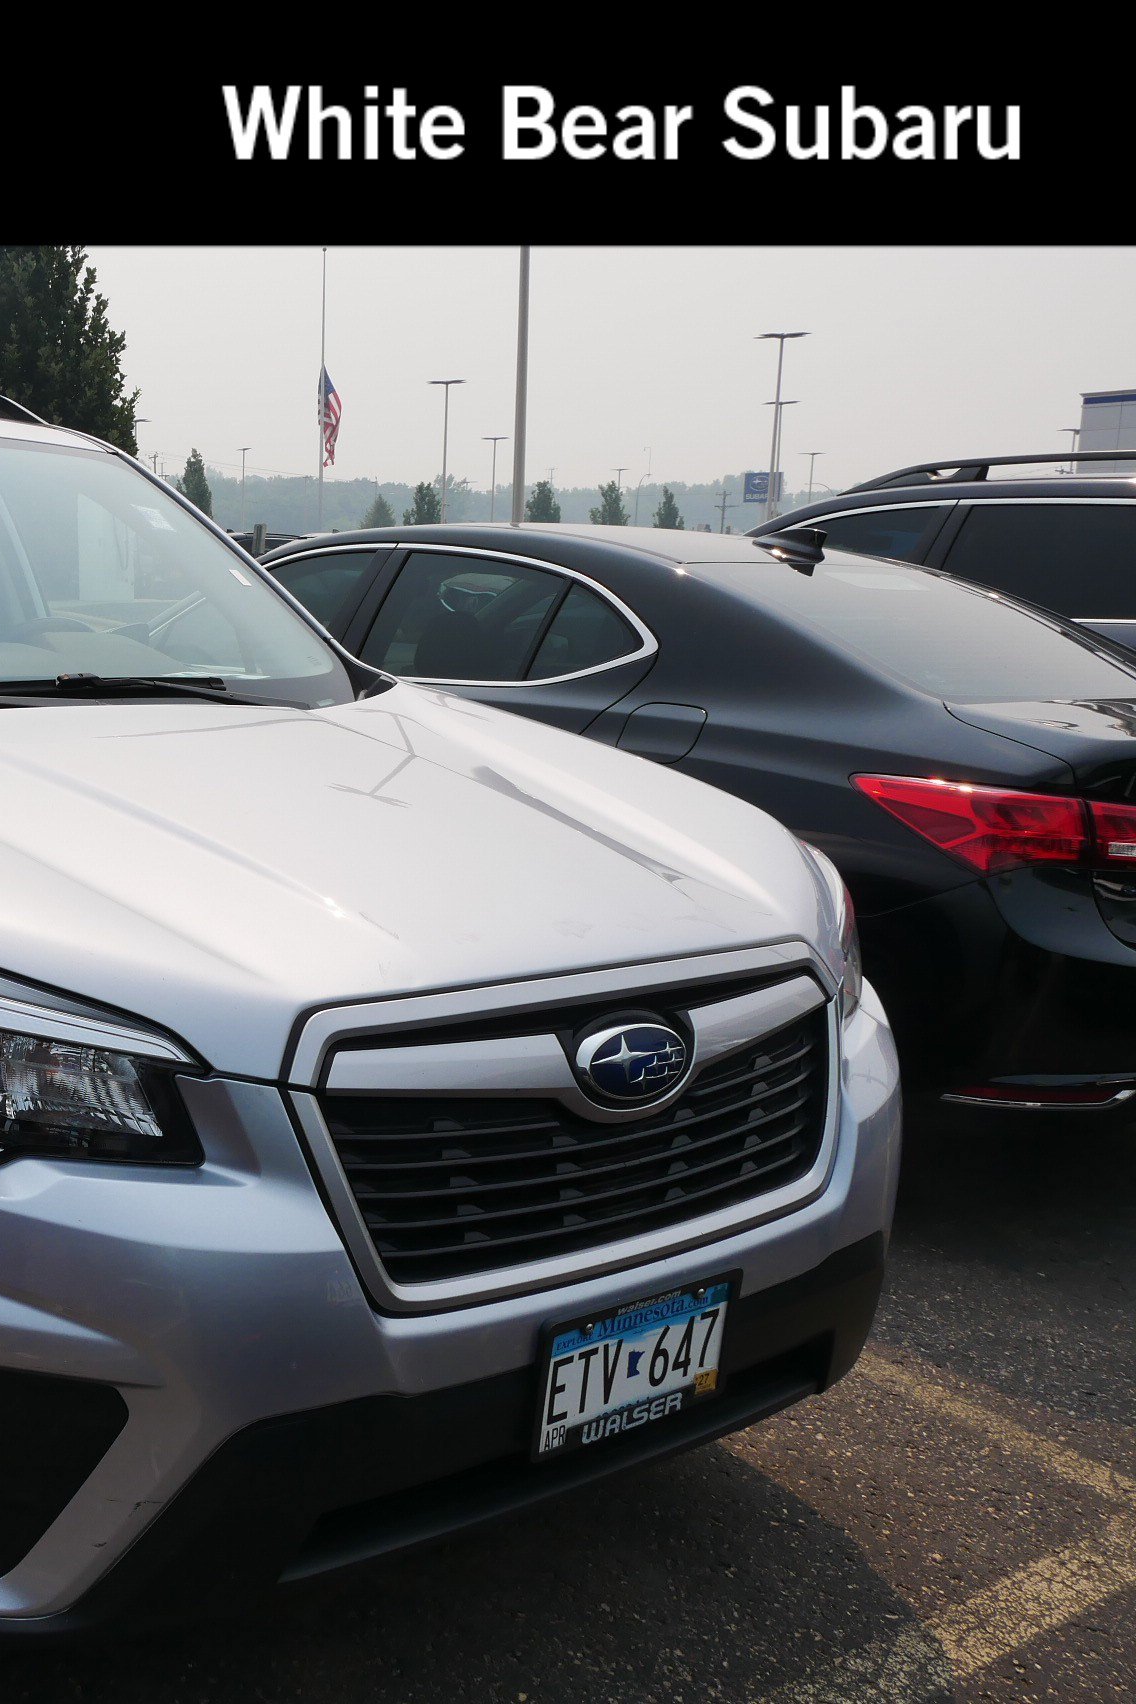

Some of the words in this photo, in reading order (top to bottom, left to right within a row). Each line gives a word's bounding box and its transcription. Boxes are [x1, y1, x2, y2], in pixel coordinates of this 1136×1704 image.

[546, 1338, 624, 1426] ETV
[648, 1308, 720, 1387] 647
[544, 1425, 566, 1451] APR
[581, 1391, 683, 1444] WALSER
